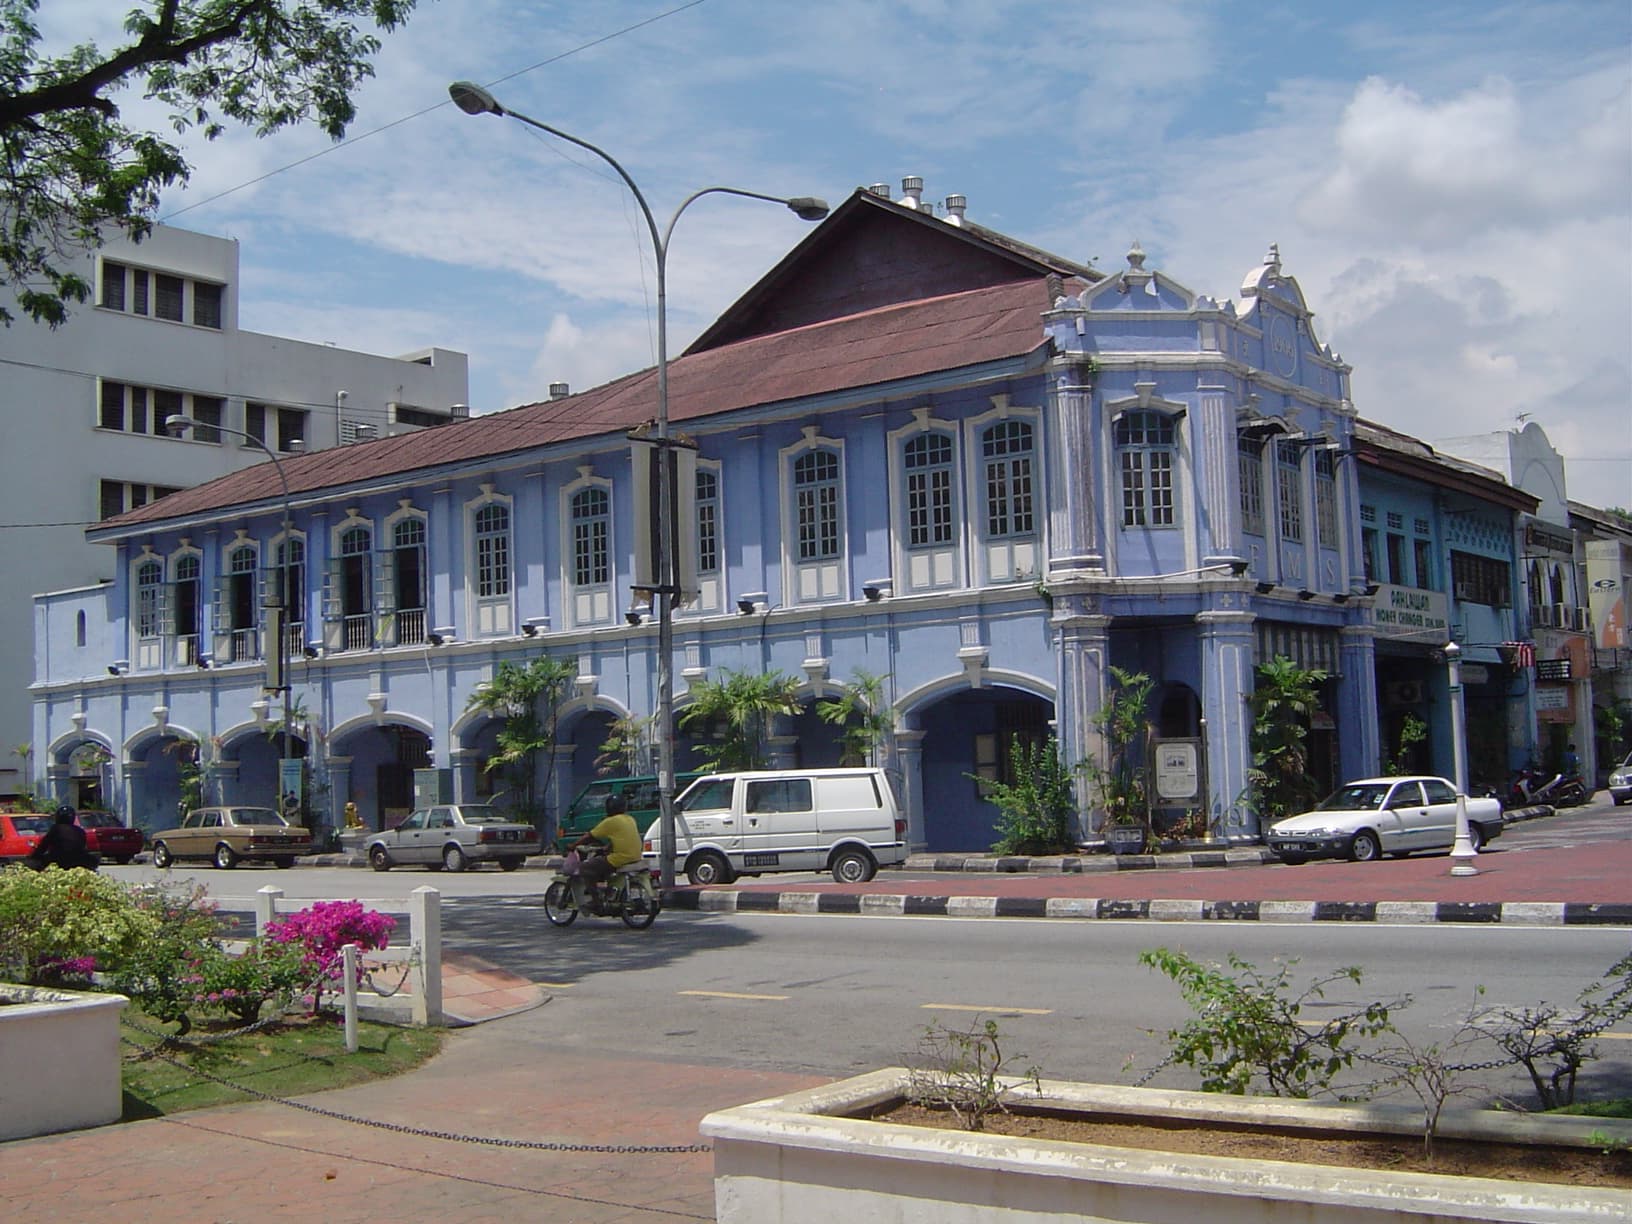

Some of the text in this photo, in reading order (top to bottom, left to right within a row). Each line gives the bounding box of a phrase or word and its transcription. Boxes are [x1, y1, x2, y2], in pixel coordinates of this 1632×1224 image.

[1248, 544, 1335, 586] F M S
[1376, 608, 1396, 623] MONEY
[1398, 611, 1424, 626] CHANGER
